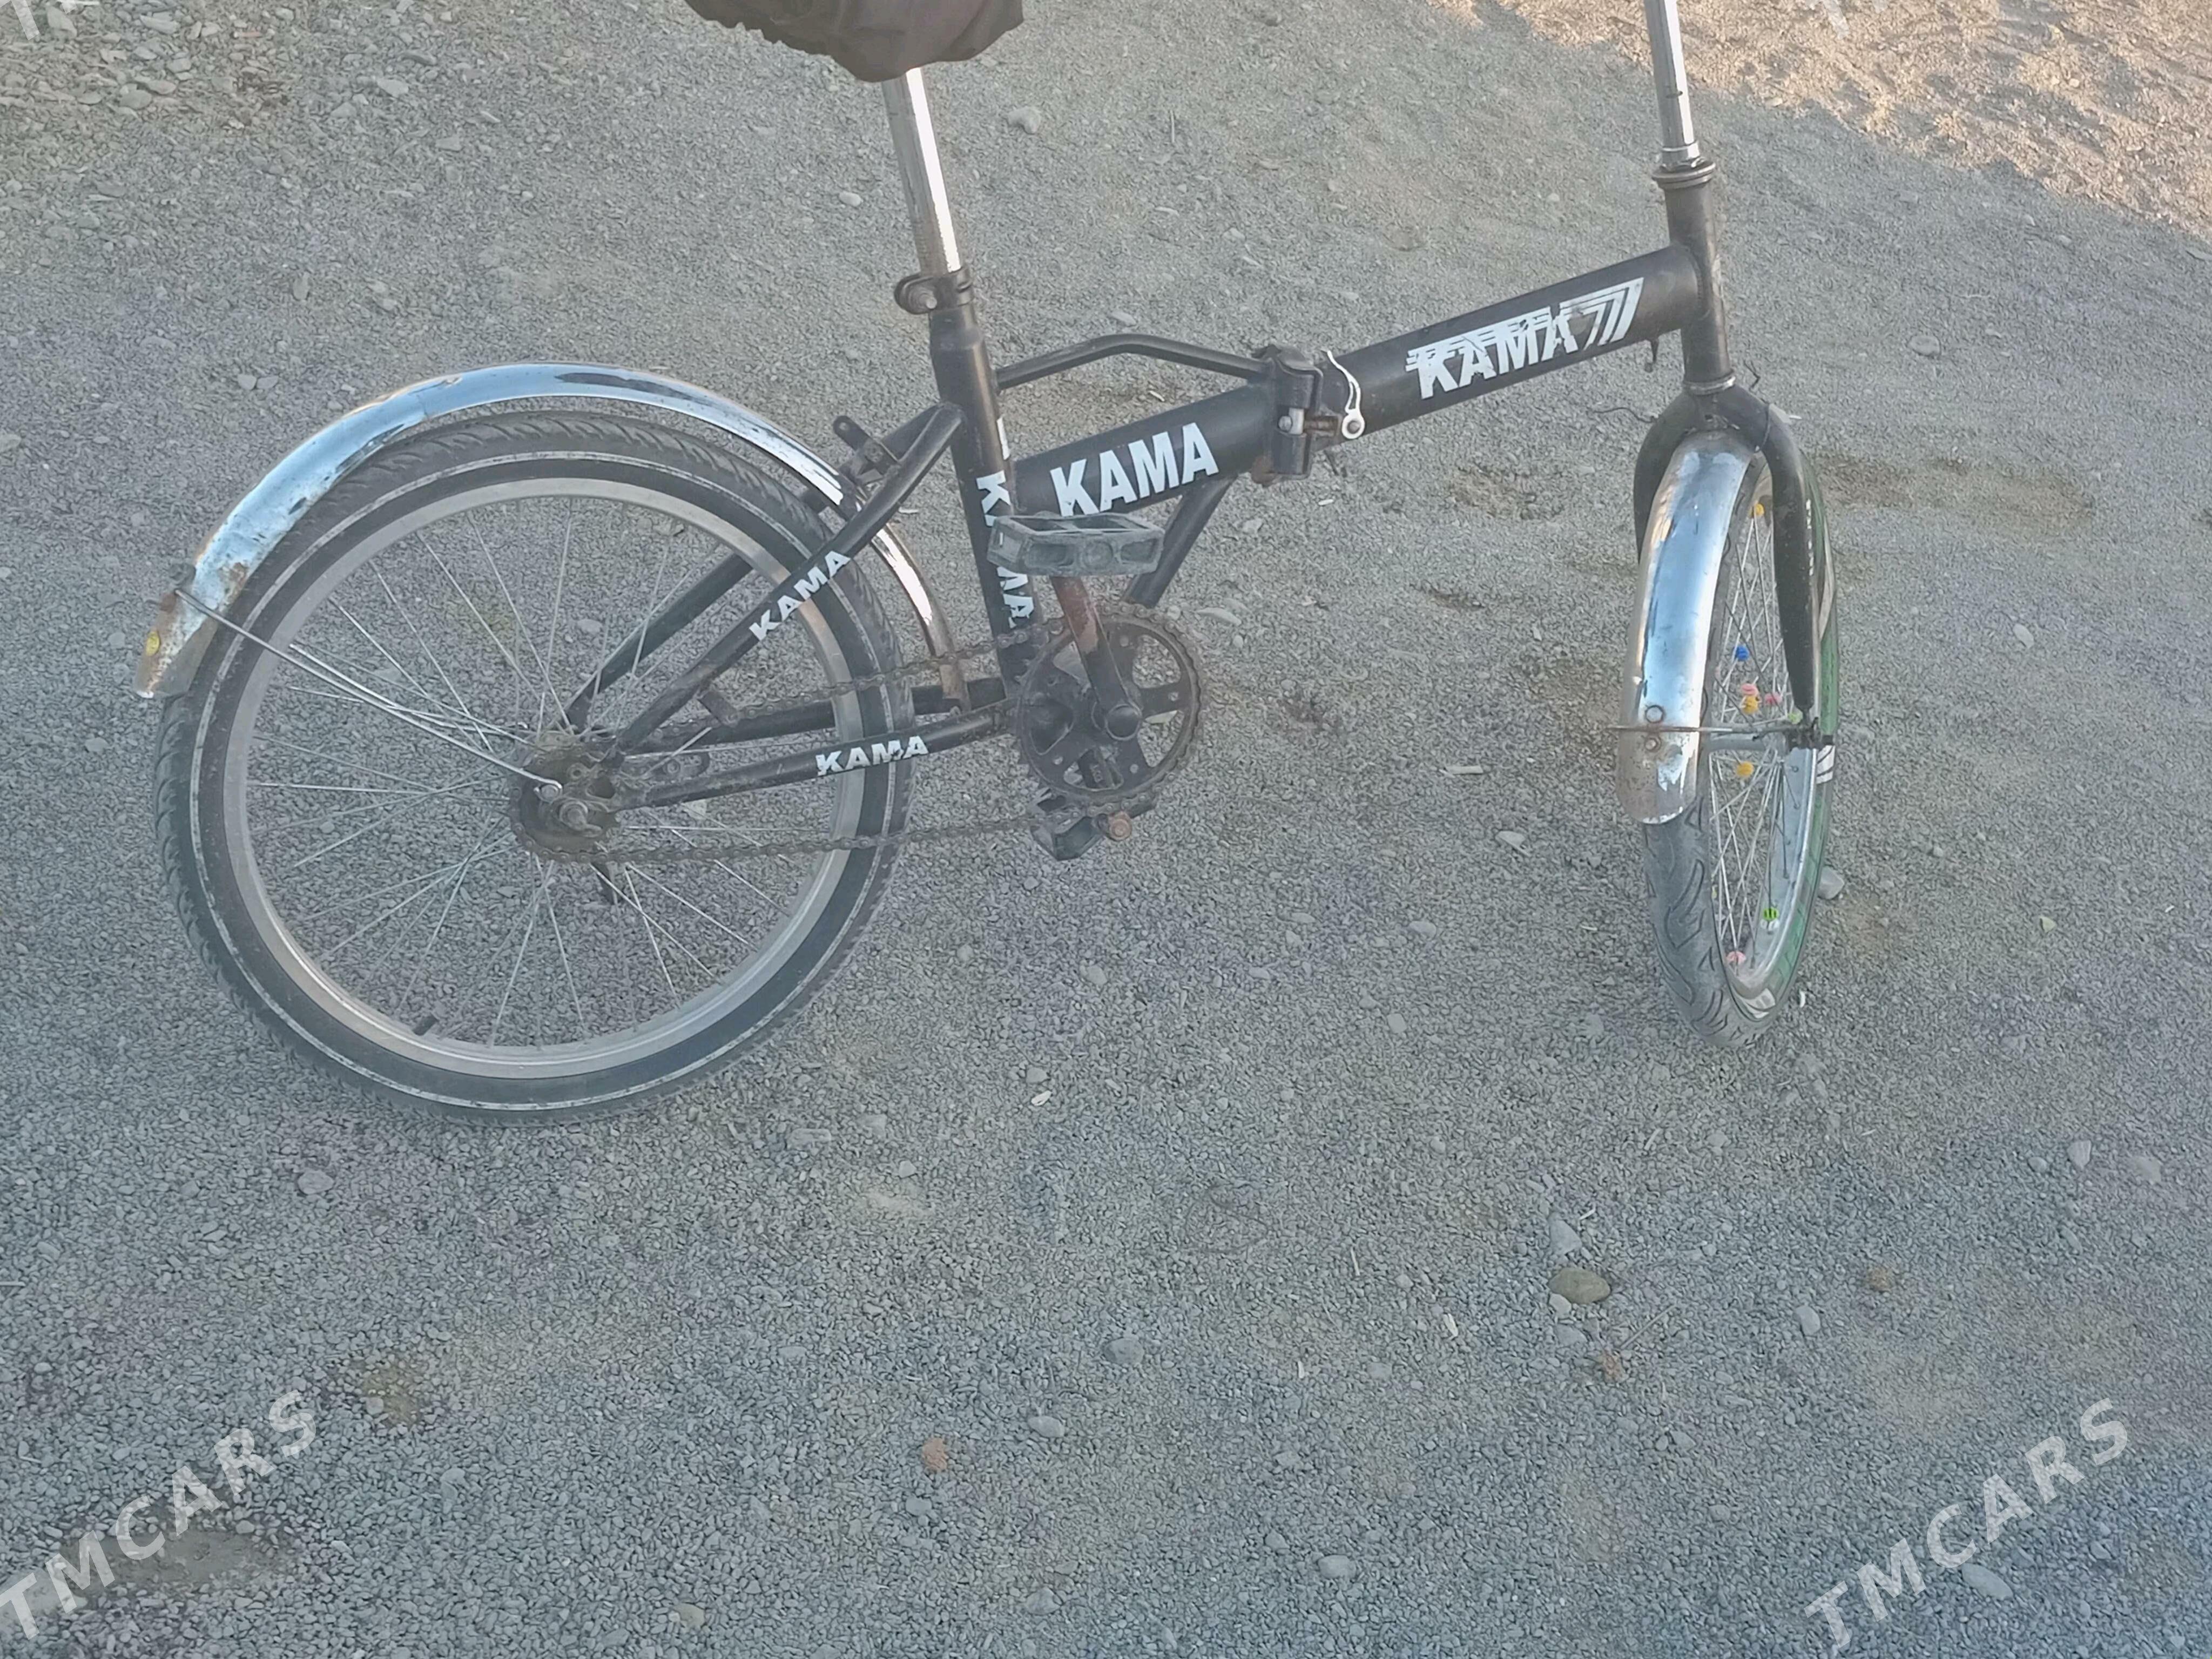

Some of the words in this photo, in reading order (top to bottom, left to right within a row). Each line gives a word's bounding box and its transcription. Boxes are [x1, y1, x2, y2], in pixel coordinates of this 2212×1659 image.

[1050, 422, 1219, 516] KAMA
[749, 551, 851, 640] KAMA
[815, 736, 929, 775] KAMA
